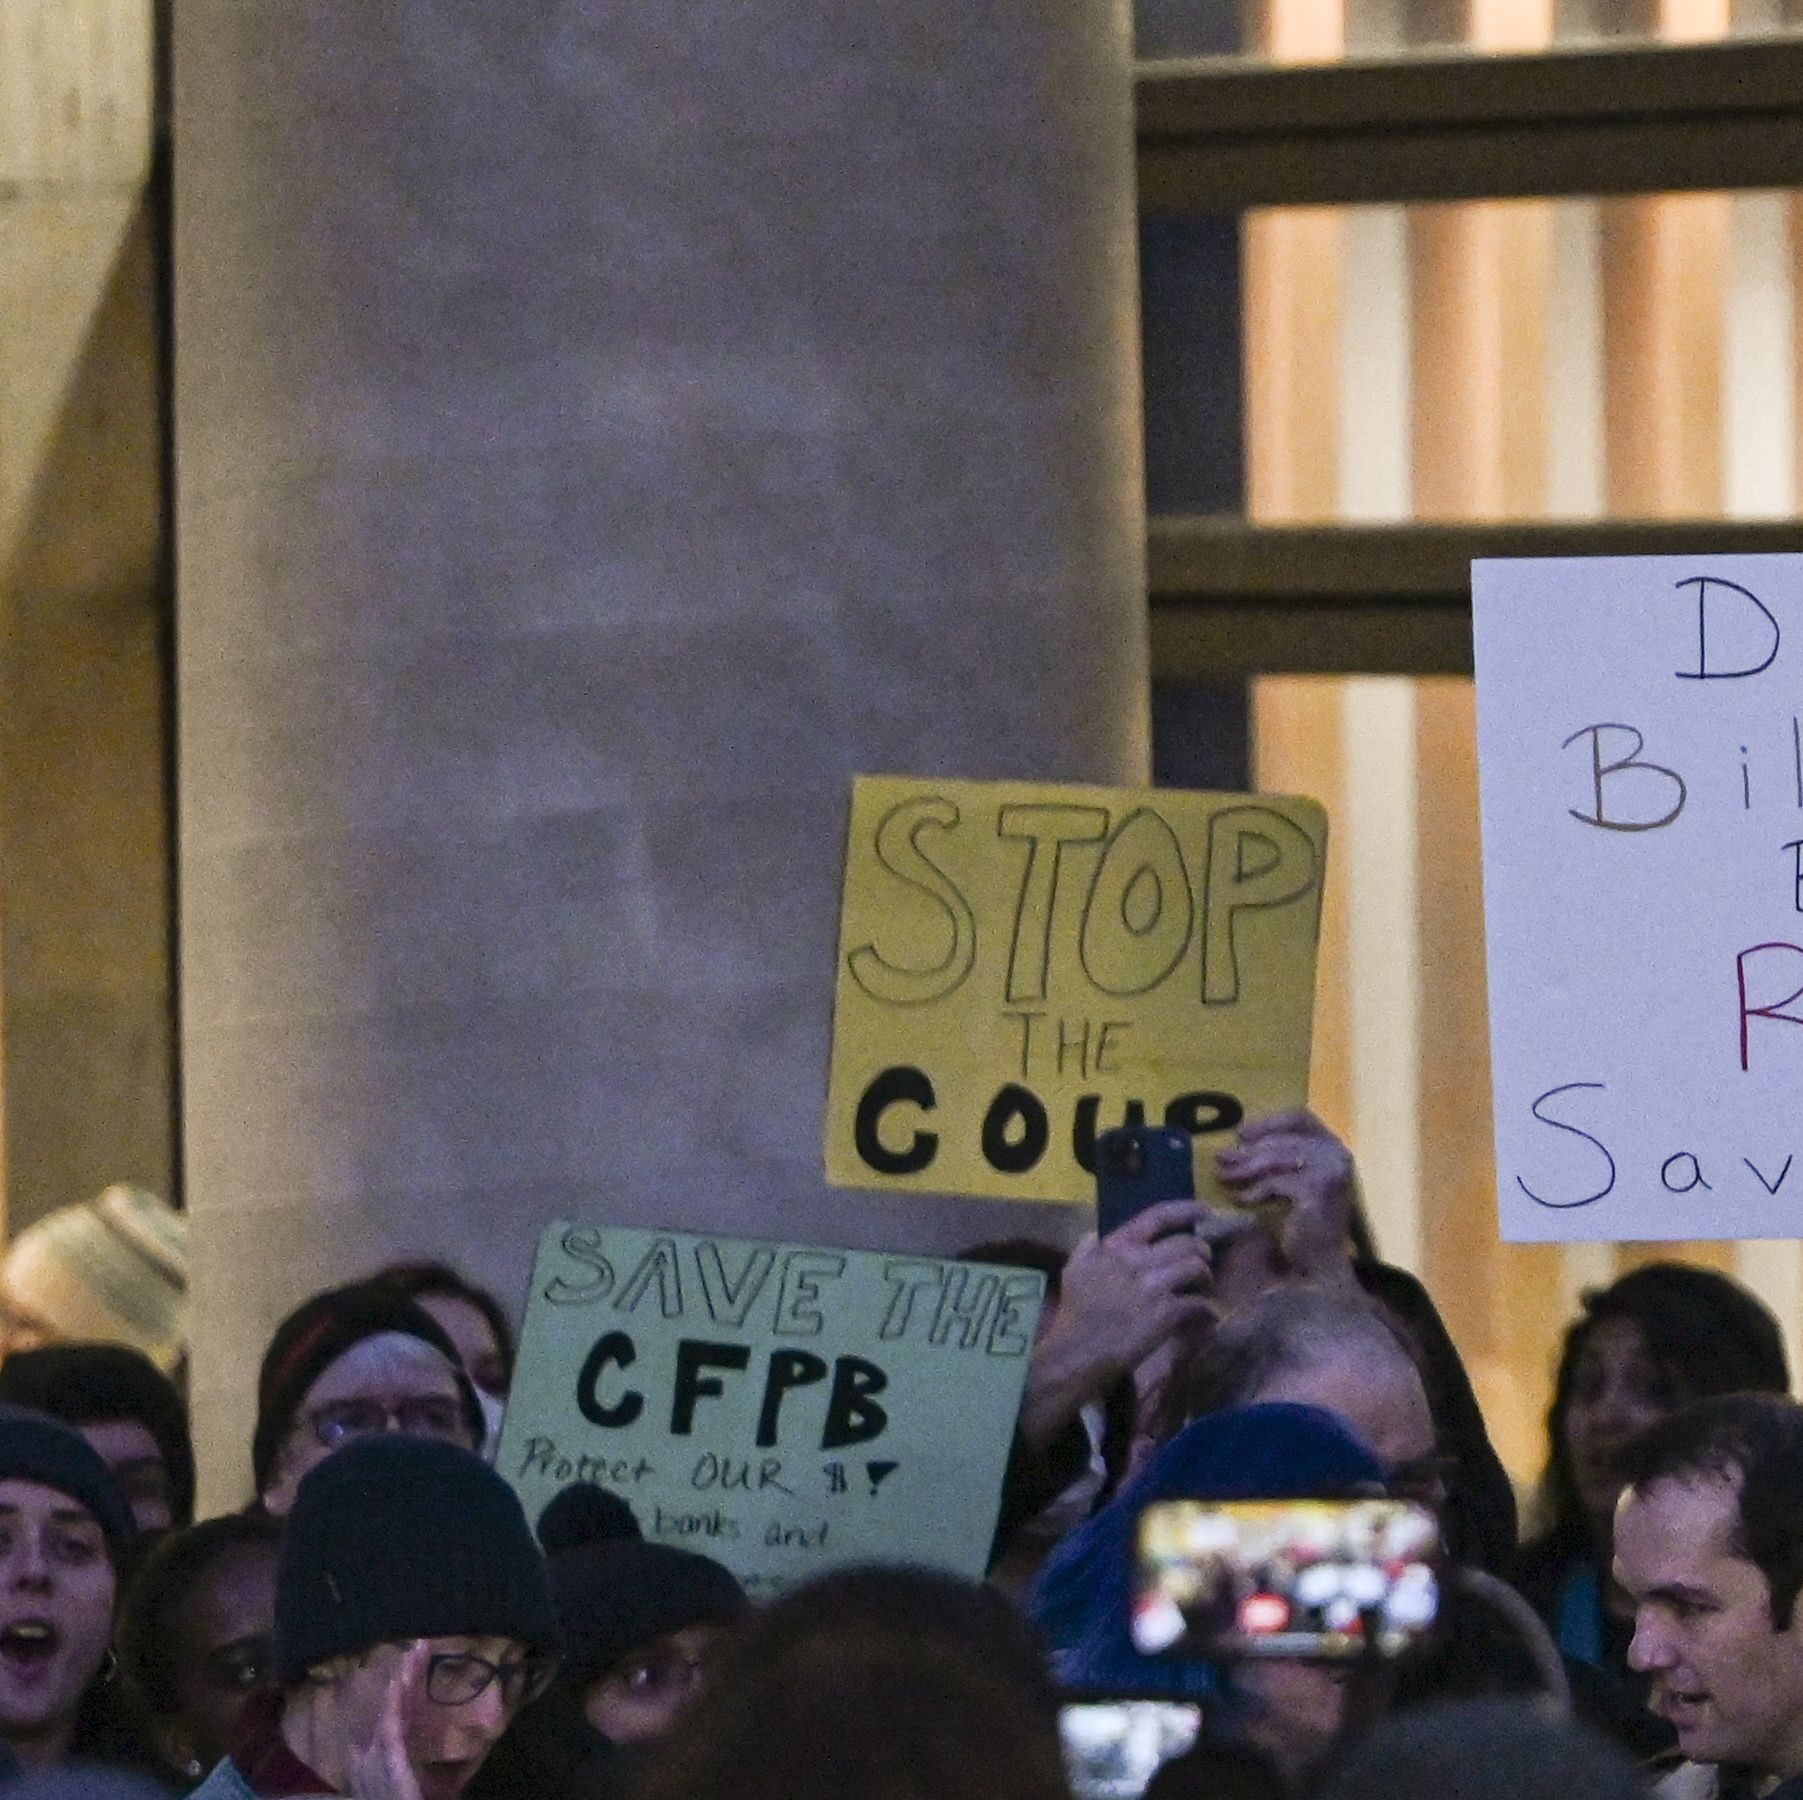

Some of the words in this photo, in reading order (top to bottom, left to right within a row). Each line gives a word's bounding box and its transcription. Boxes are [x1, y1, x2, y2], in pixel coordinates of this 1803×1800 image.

[847, 796, 1319, 1008] STOP
[1003, 1011, 1133, 1080] THE
[543, 1228, 847, 1338] SAVE
[878, 1263, 1040, 1360] THE
[576, 1331, 890, 1452] CFPB
[517, 1436, 655, 1484] Protect
[691, 1456, 794, 1495] OUR
[654, 1506, 741, 1540] banks
[764, 1521, 829, 1548] and
